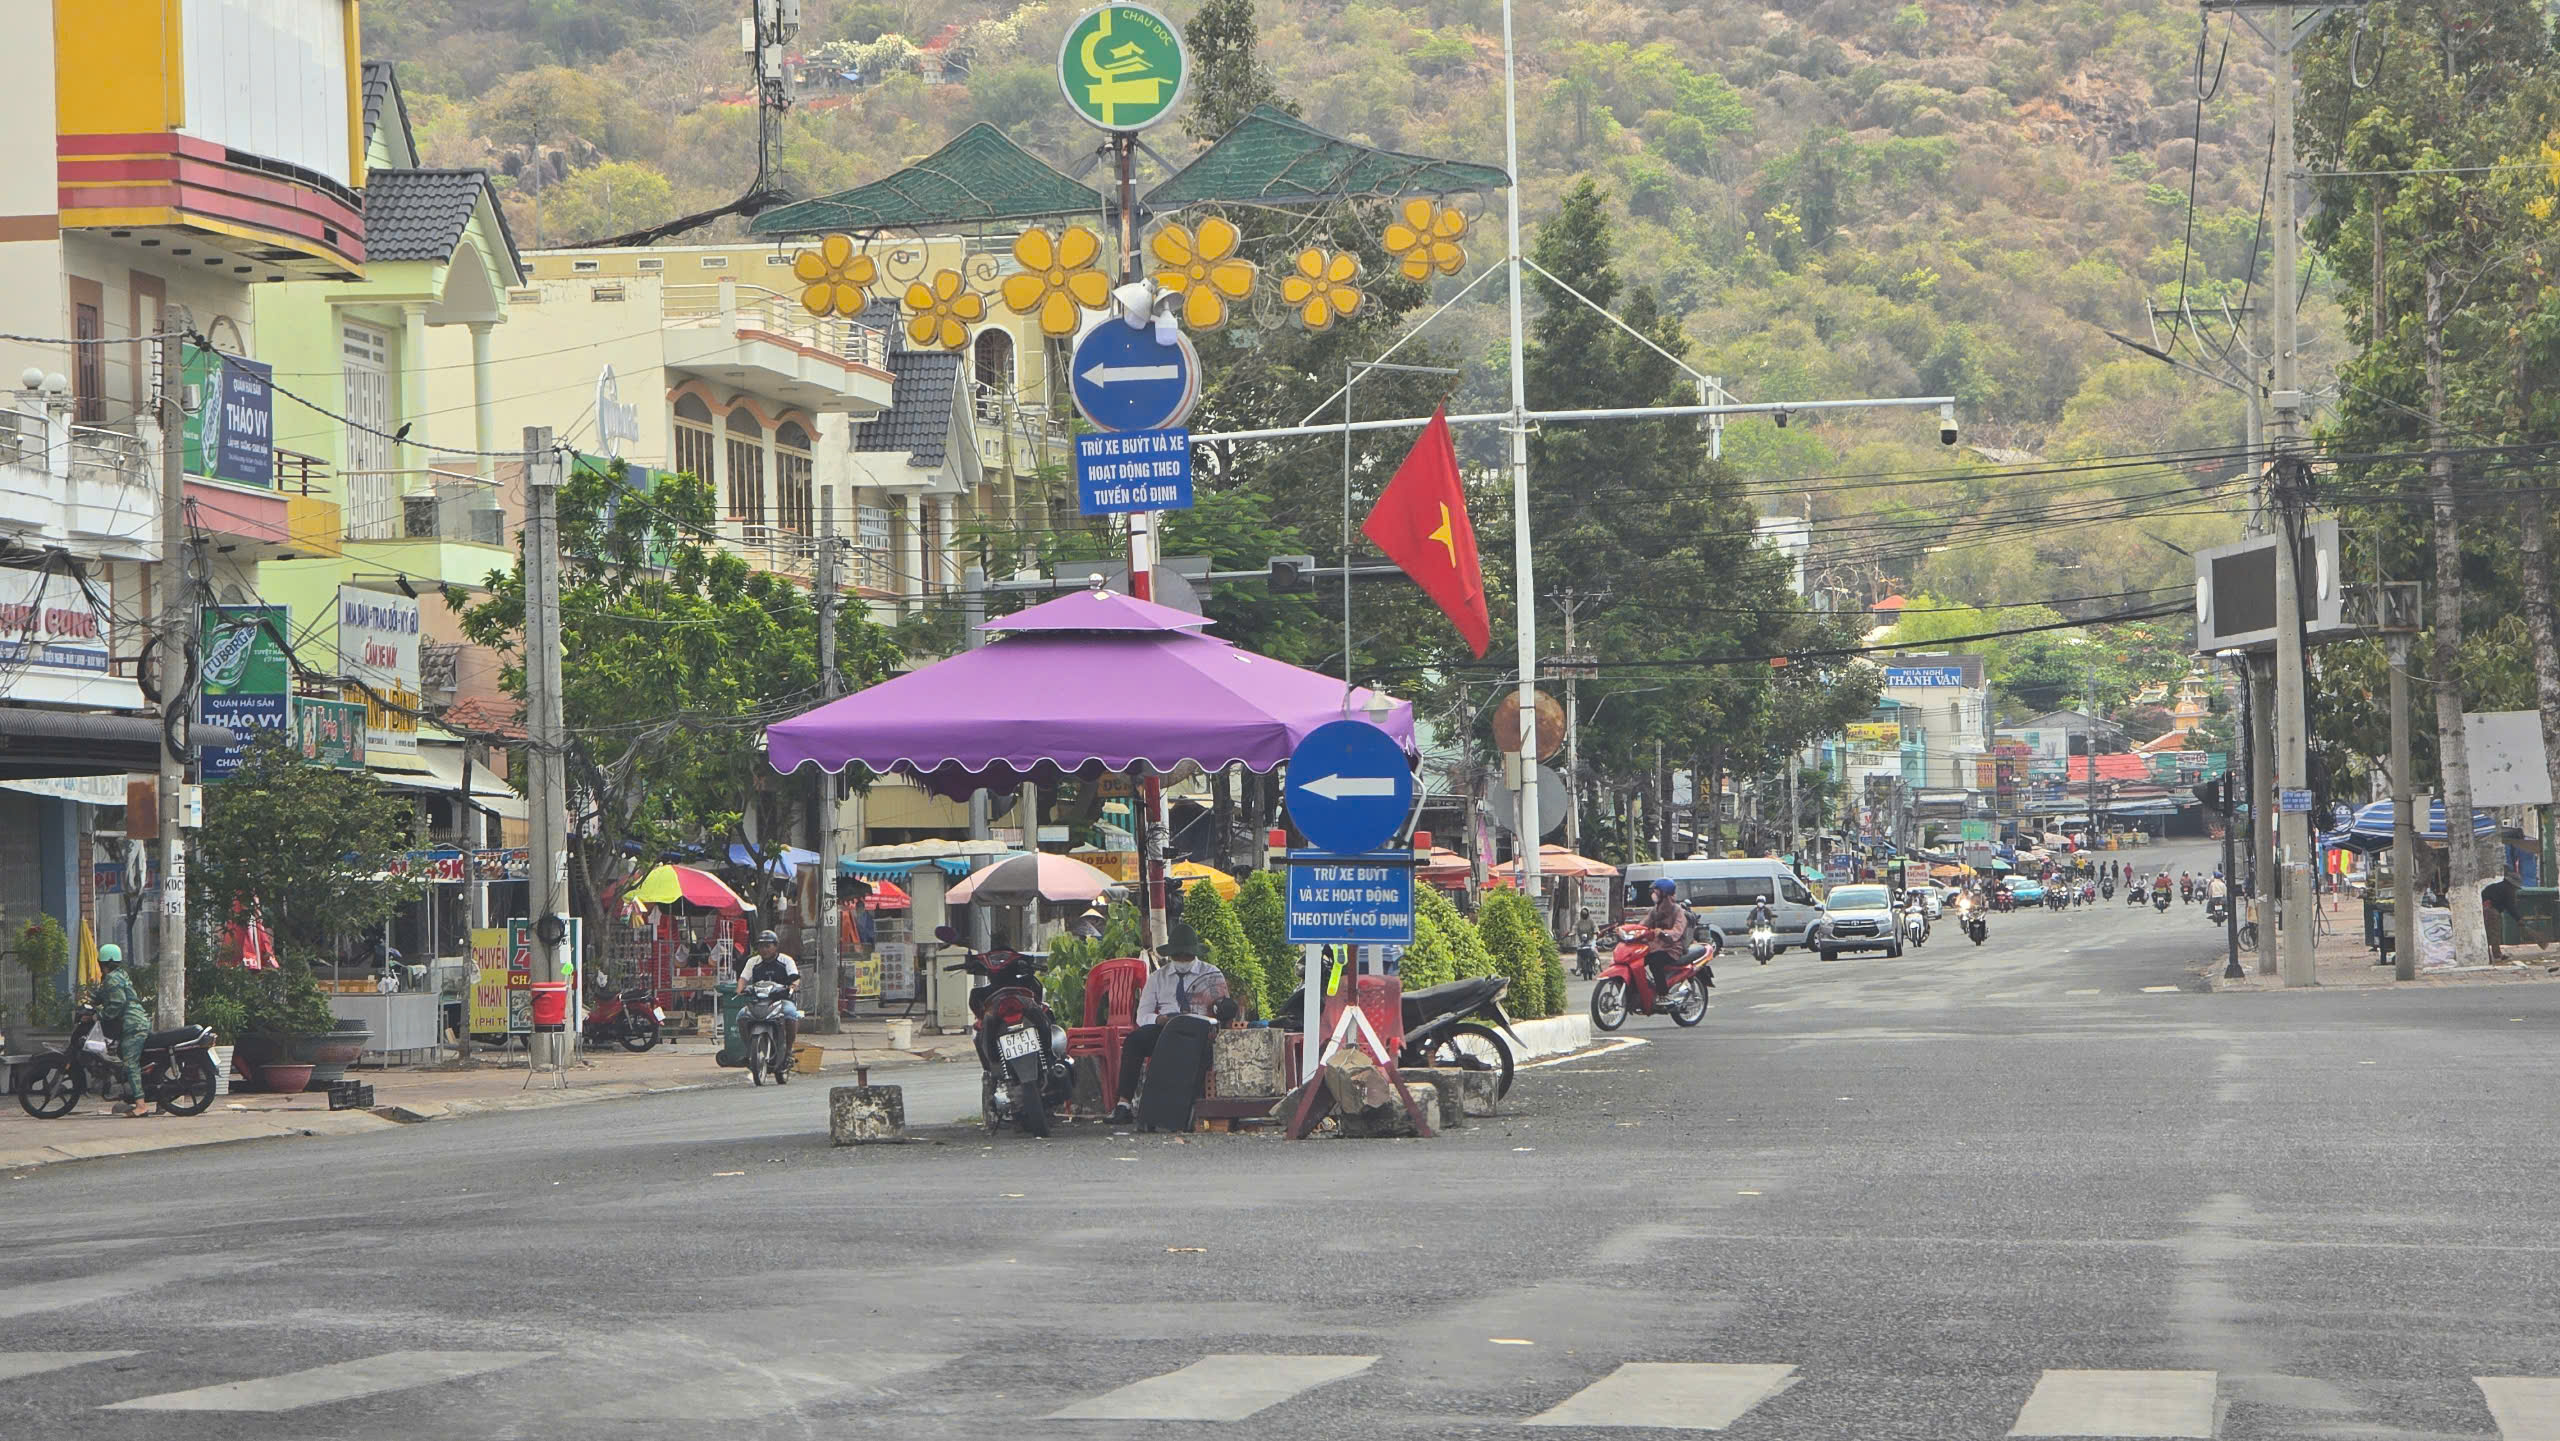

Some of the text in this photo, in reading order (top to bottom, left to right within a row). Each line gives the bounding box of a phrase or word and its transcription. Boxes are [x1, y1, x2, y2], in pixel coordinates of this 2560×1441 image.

[1122, 9, 1153, 27] CHAU
[227, 396, 268, 438] THẢO VY
[1081, 433, 1184, 456] TRỪ XE BUÝT VÀ XE
[1088, 460, 1180, 483] HOẠT ĐỘNG THEO
[1094, 482, 1177, 506] TUYẾN CỐ ĐỊNH
[1888, 674, 1960, 686] THANH VÂN
[213, 698, 238, 708] QUÁN
[257, 698, 275, 708] SẢN
[205, 709, 283, 728] THẢO VY
[1340, 868, 1354, 880] XE
[1300, 885, 1399, 905] VÀ XE HOẠT ĐỘNG
[1380, 913, 1408, 930] ĐỊNH
[1006, 1040, 1038, 1058] 019.75
